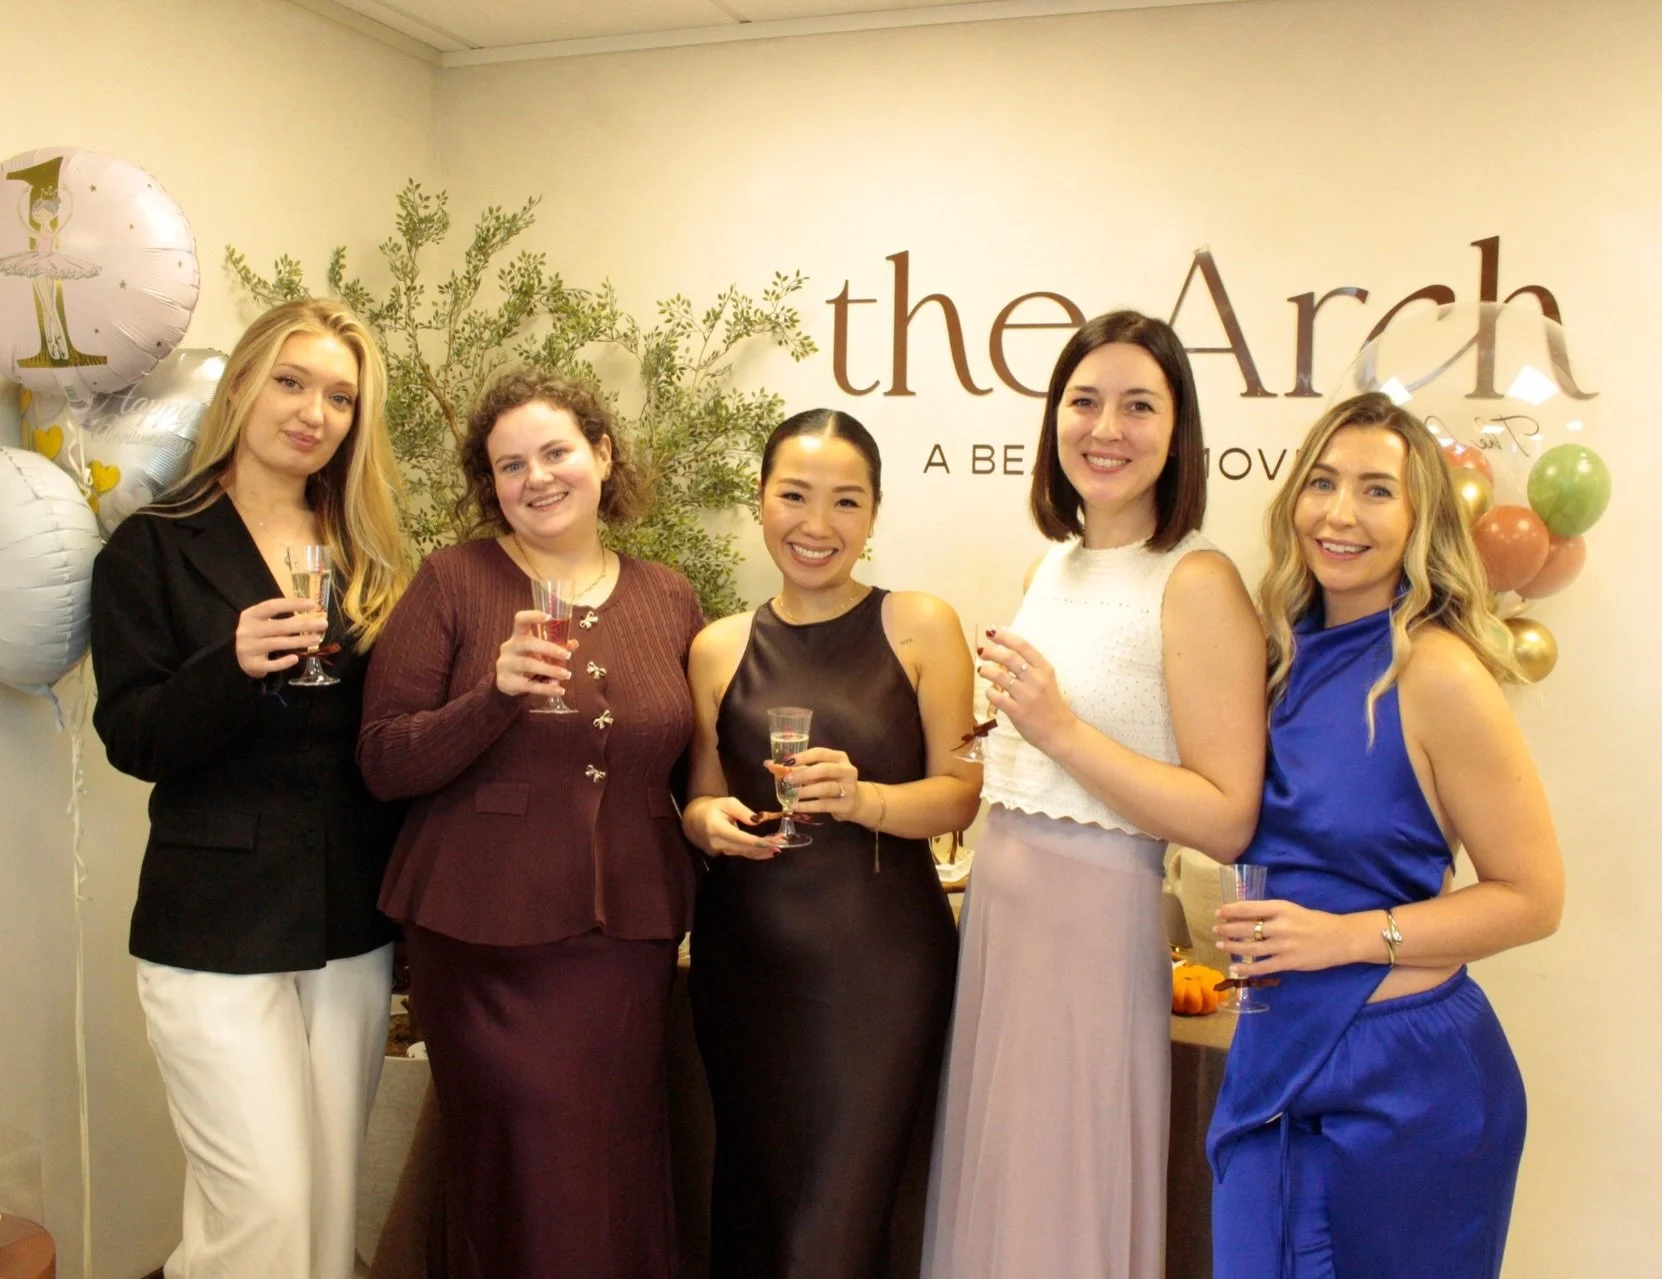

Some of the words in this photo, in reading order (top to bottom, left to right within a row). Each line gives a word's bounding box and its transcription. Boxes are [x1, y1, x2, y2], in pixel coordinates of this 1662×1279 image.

[6, 156, 108, 368] 1
[825, 250, 1087, 398] the
[1168, 235, 1600, 400] Arch
[923, 443, 950, 474] A
[972, 444, 1035, 476] BE
